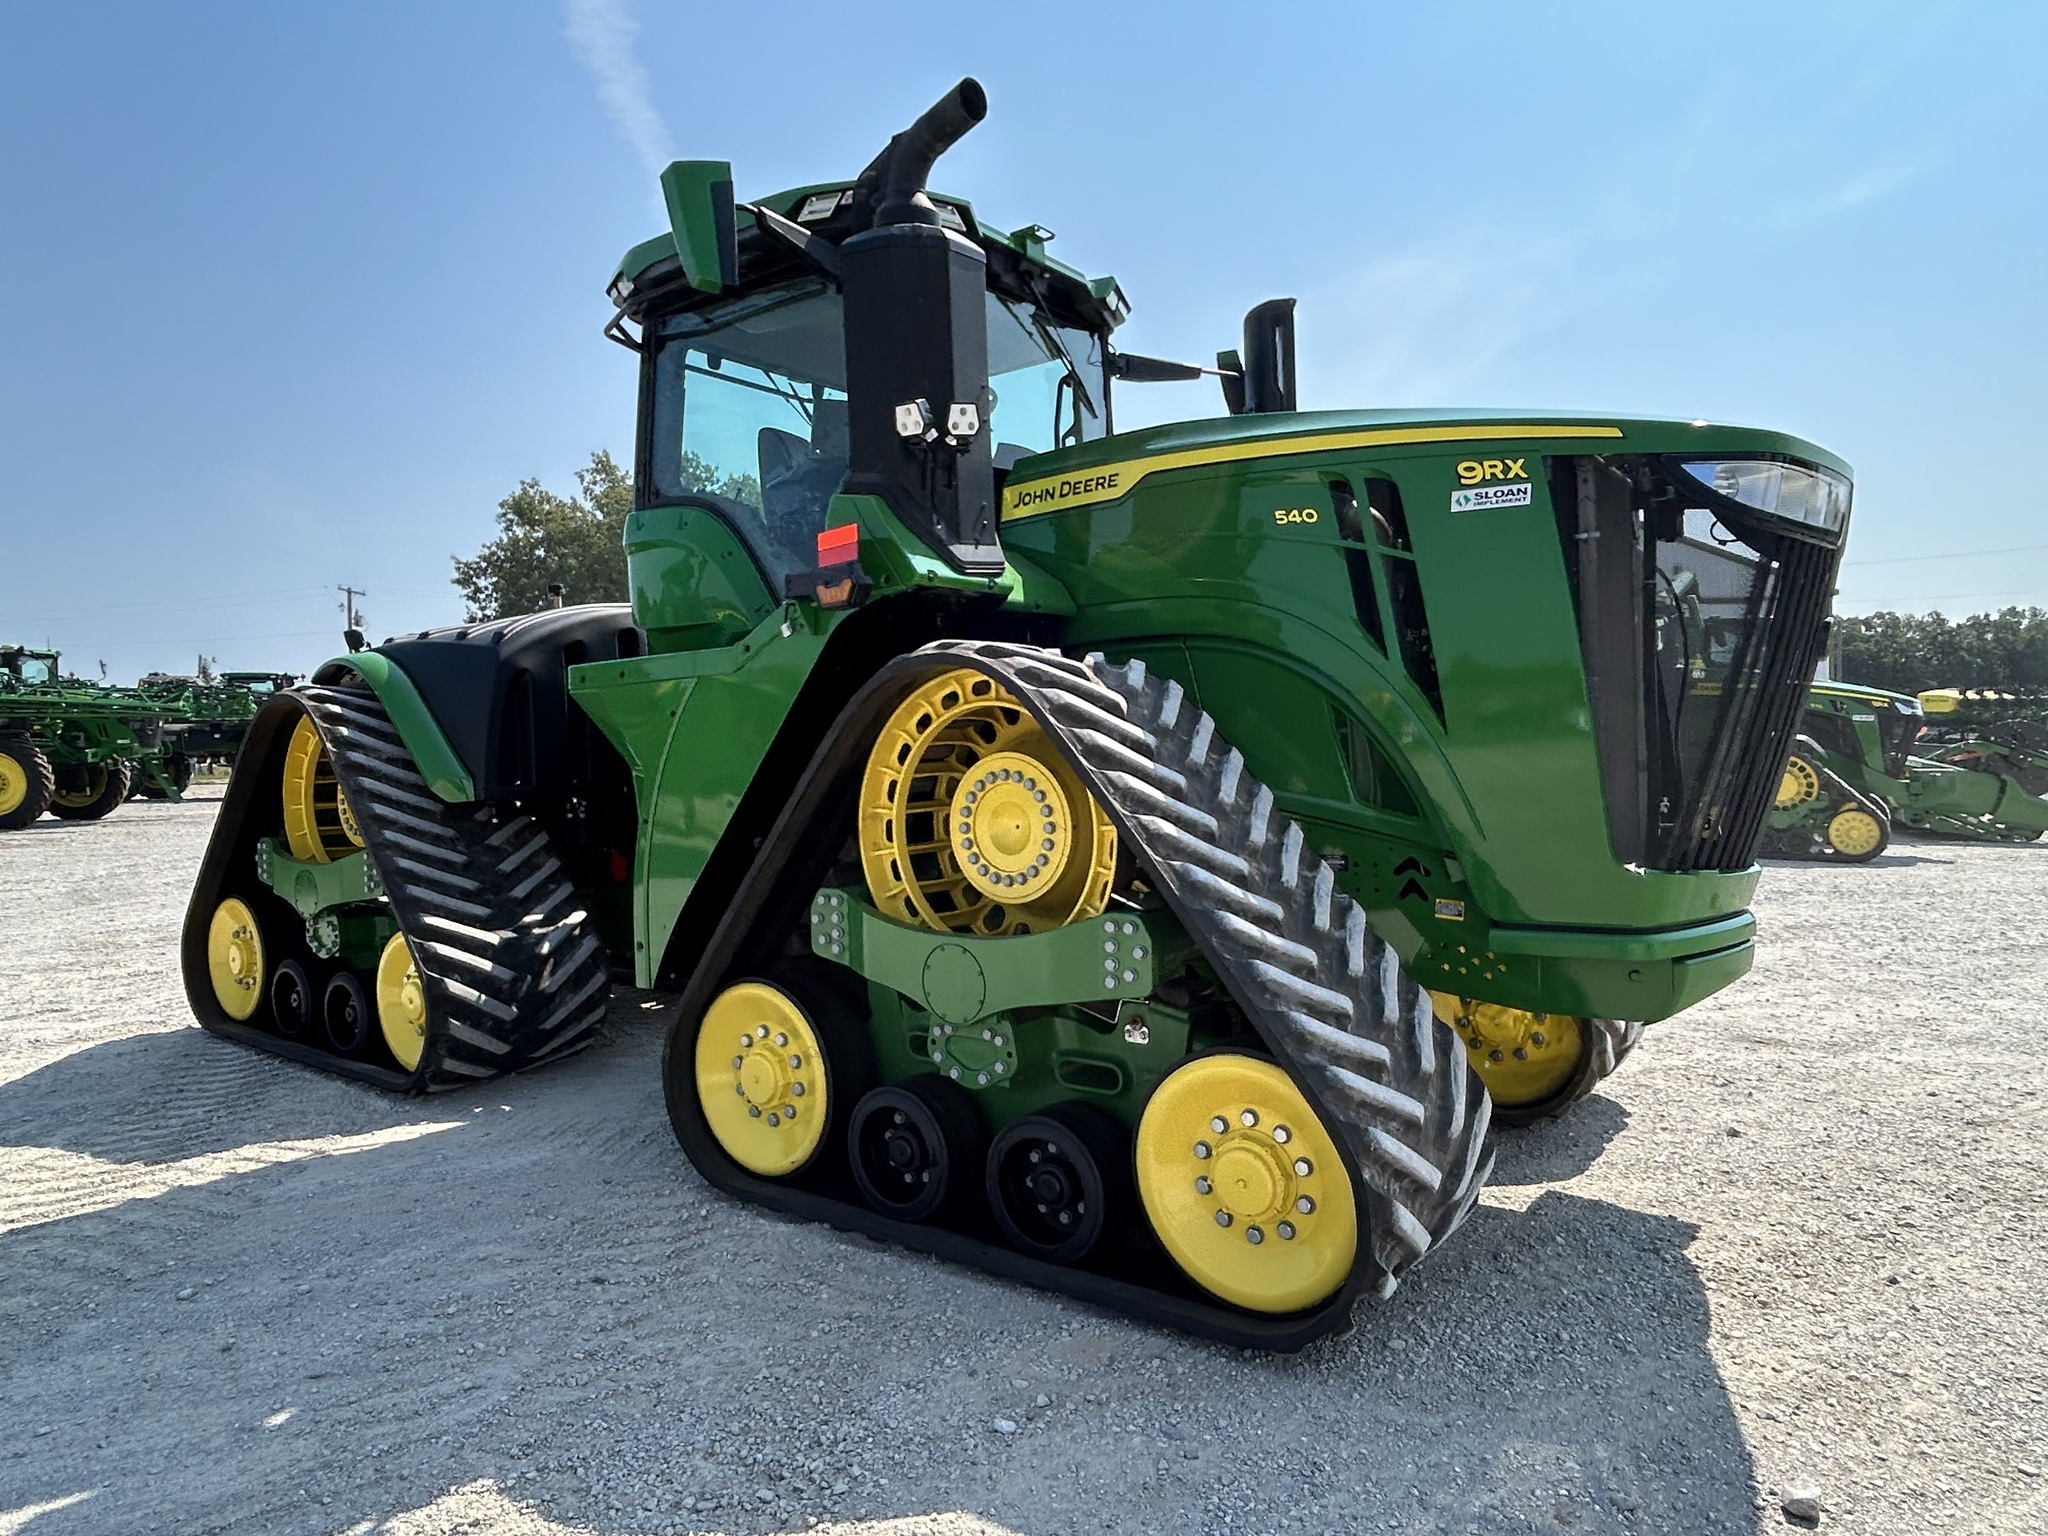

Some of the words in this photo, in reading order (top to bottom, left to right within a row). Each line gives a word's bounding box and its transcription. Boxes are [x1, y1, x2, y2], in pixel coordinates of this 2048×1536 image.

[1457, 458, 1529, 485] 9RX
[1013, 486, 1056, 509] JOHN
[1059, 473, 1120, 498] DEERE
[1474, 487, 1528, 500] SLOAN
[1473, 497, 1527, 507] IMPLEMENT
[1274, 508, 1318, 525] 540
